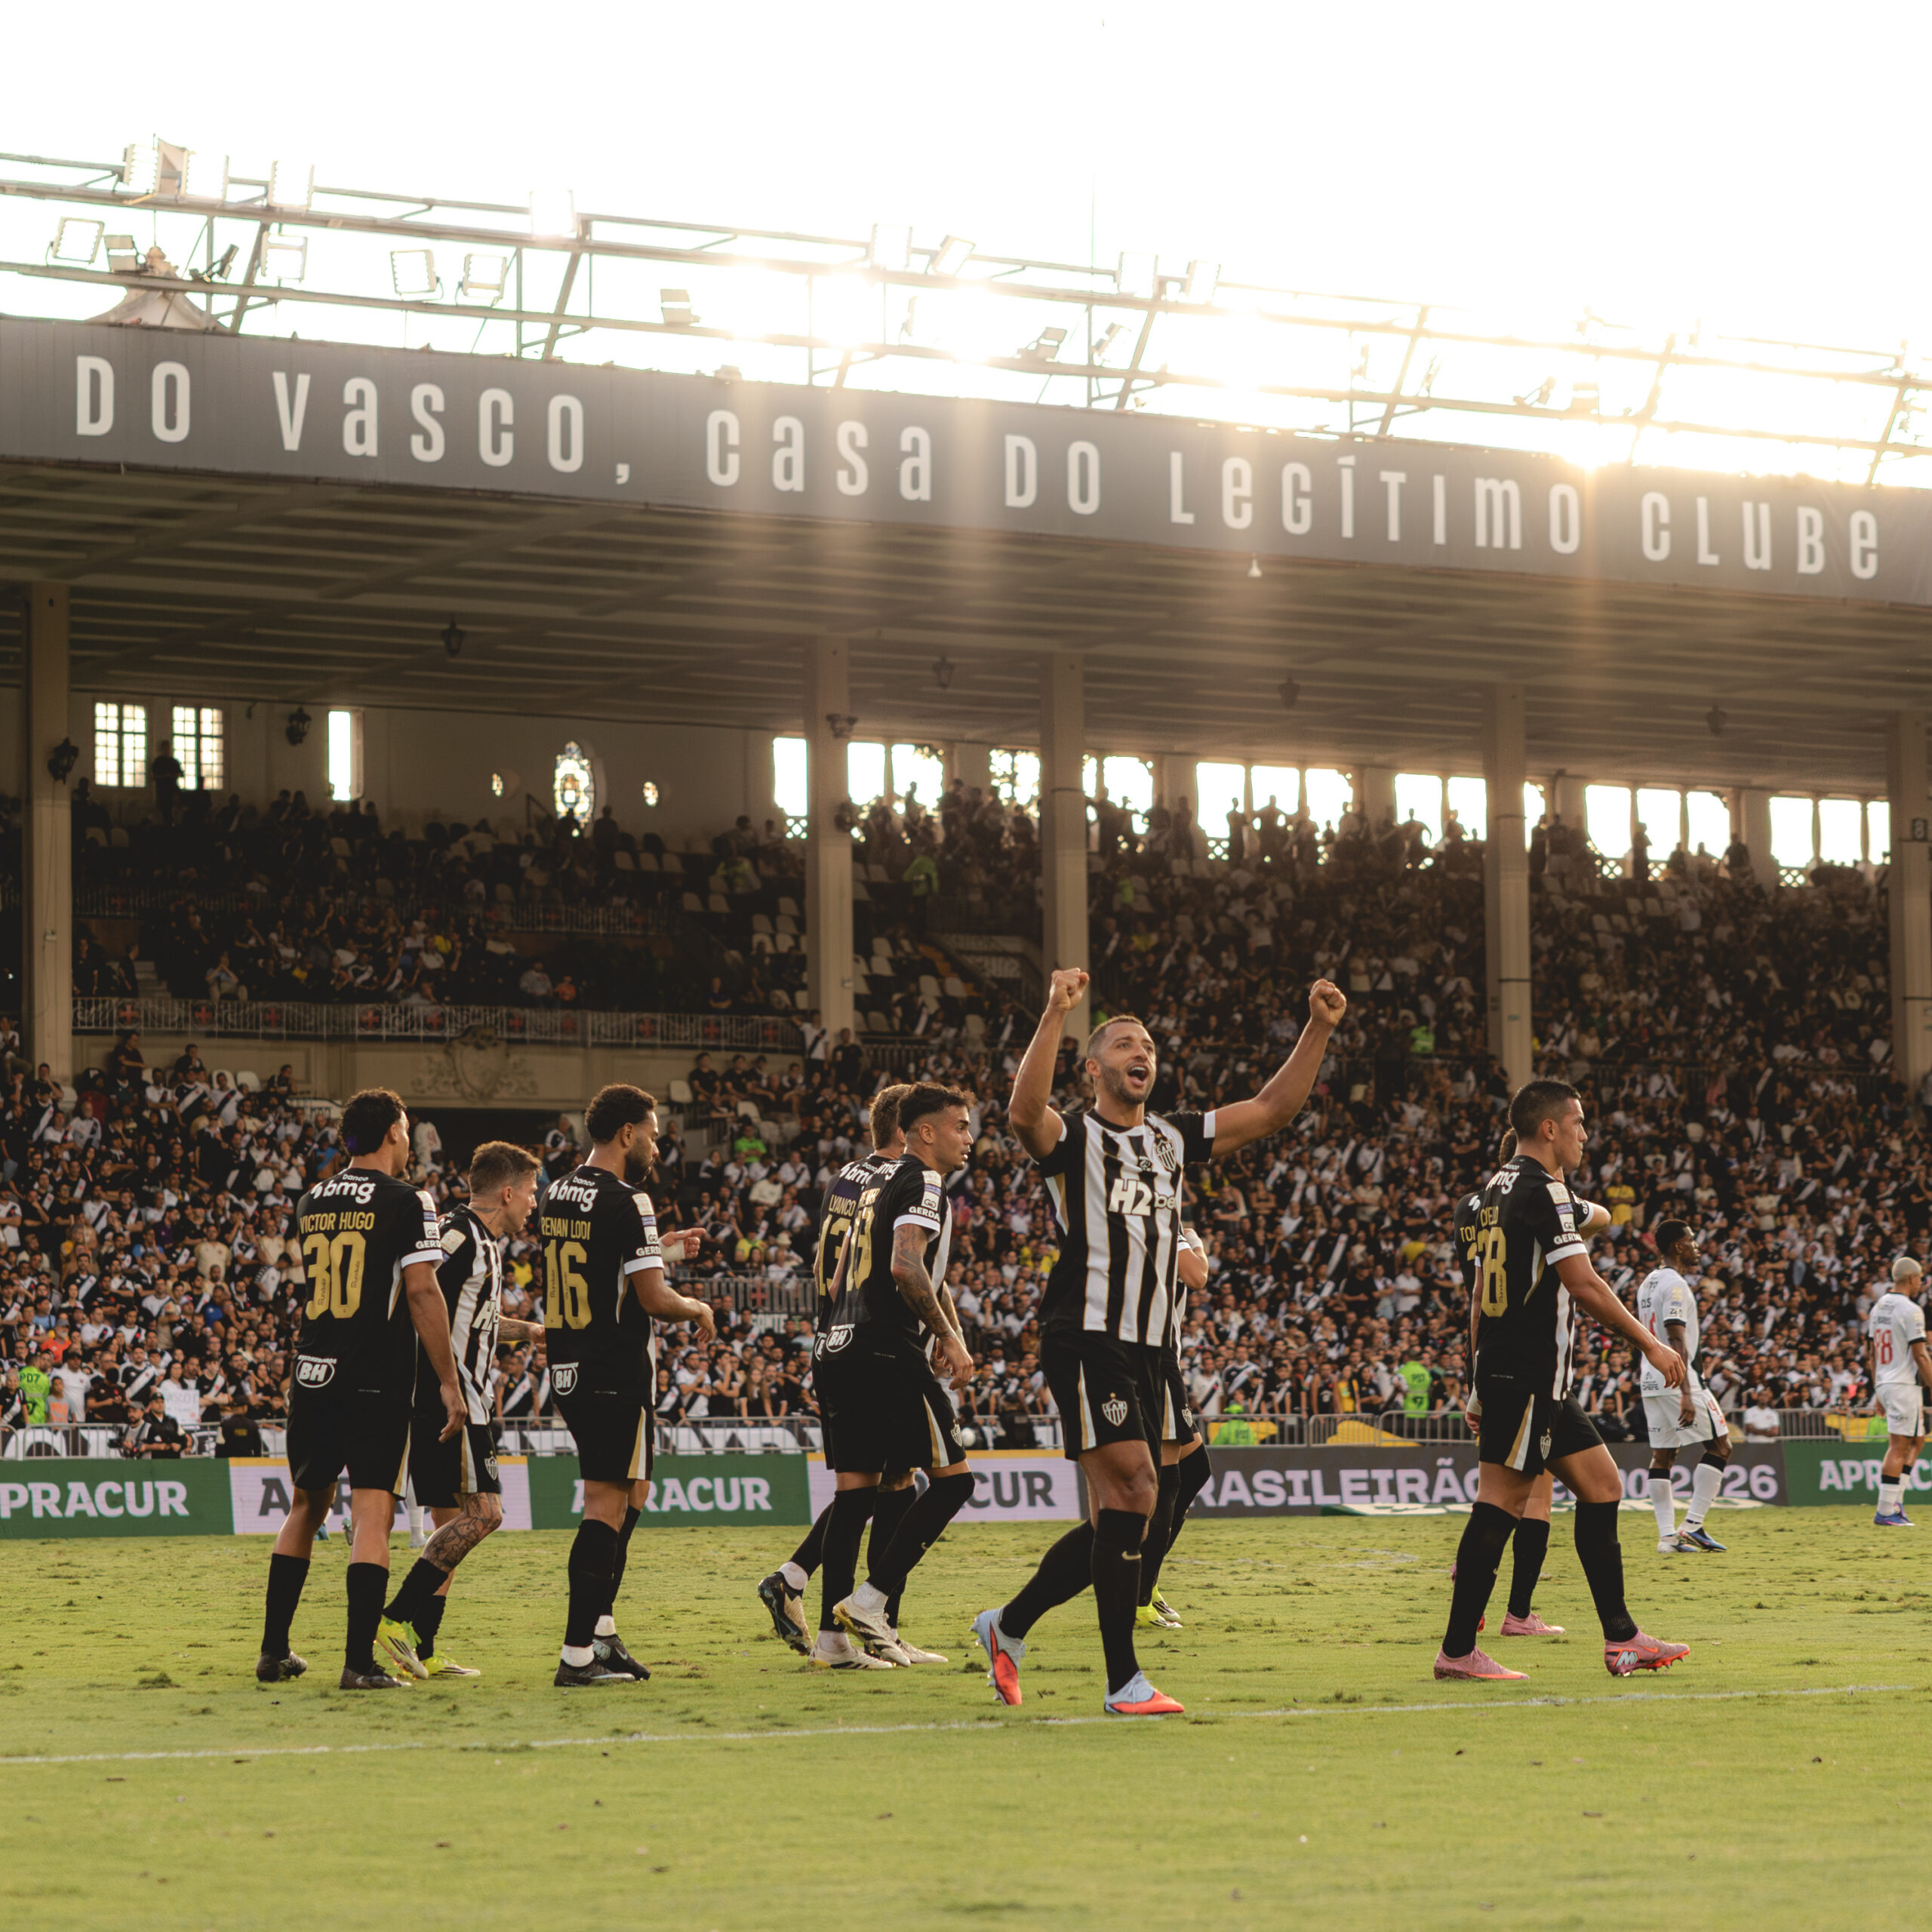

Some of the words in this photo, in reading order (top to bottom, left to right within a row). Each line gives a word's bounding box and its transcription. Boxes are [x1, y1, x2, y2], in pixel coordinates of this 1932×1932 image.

[76, 355, 191, 443] DO
[1004, 434, 1100, 515] DO
[323, 1179, 377, 1204] bmg
[1488, 1171, 1520, 1195] mg
[556, 1180, 598, 1212] bmg
[828, 1194, 857, 1217] LYANCO
[300, 1212, 337, 1234] VICTOR
[339, 1211, 375, 1230] HUGO
[541, 1217, 568, 1238] RENAN
[571, 1219, 591, 1240] LODI
[303, 1231, 366, 1320] 30
[544, 1239, 592, 1330] 16
[828, 1330, 848, 1347] BH
[298, 1361, 328, 1382] BH
[555, 1369, 573, 1389] BH
[1669, 1464, 1778, 1500] 226
